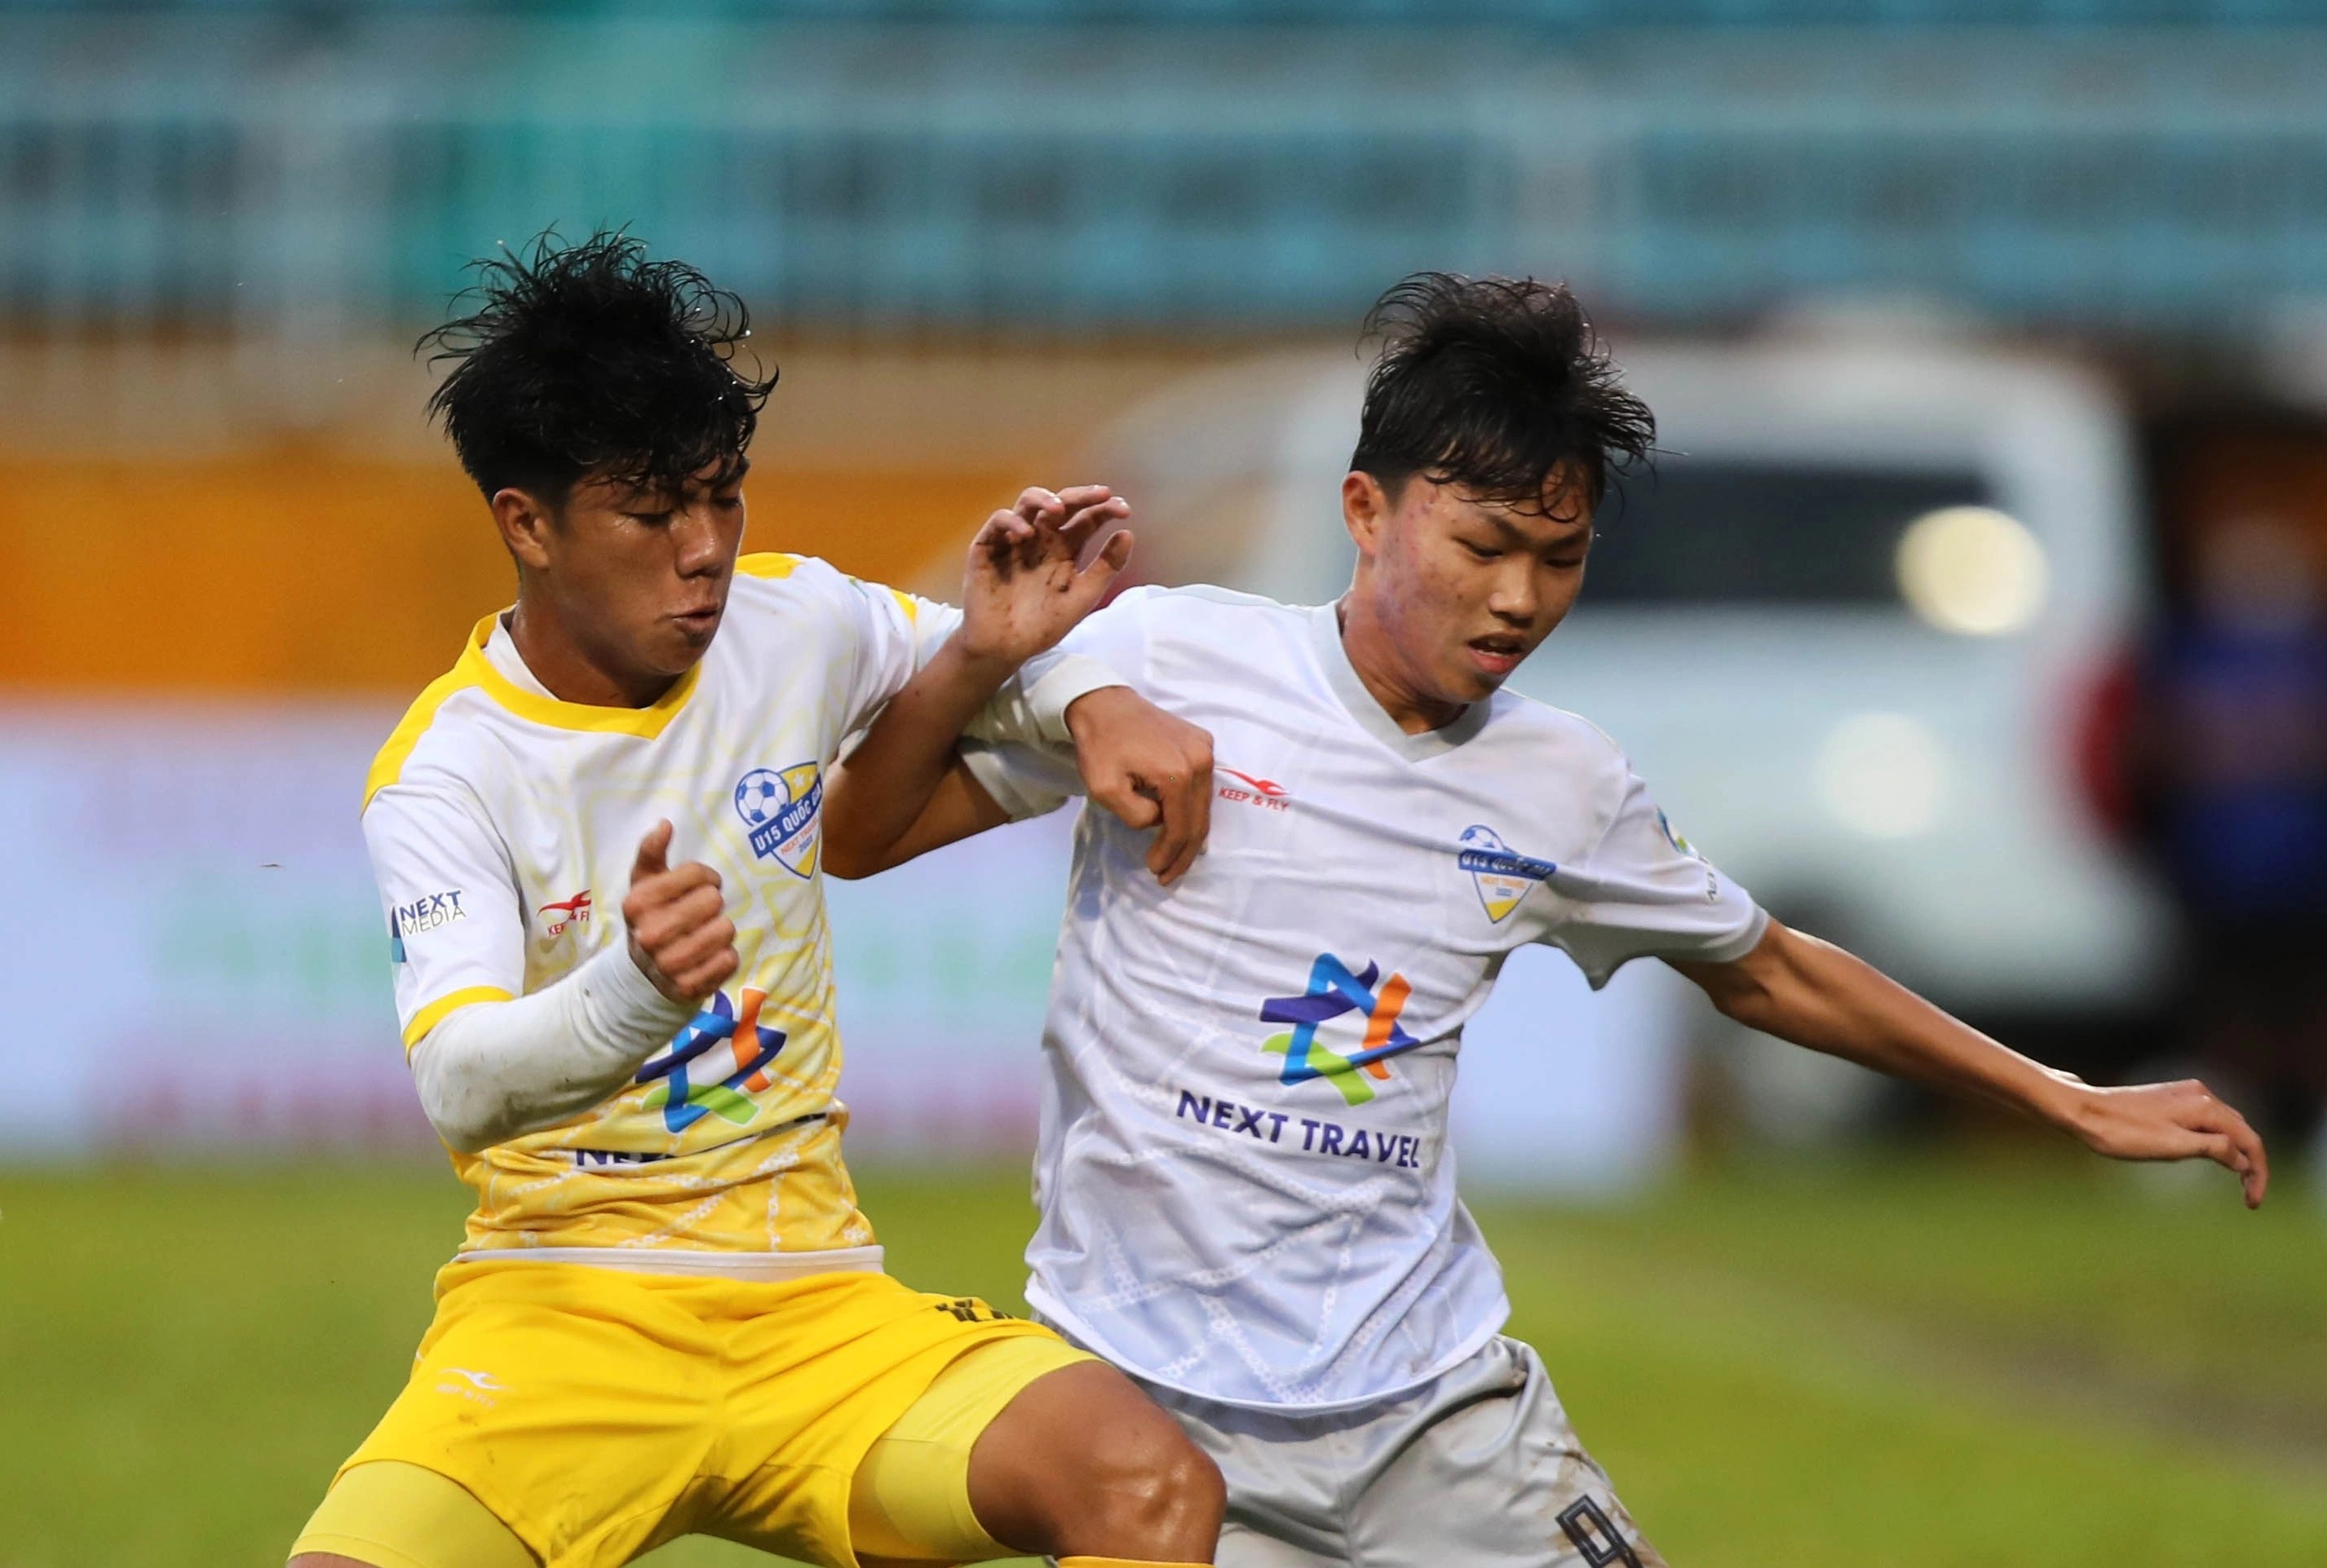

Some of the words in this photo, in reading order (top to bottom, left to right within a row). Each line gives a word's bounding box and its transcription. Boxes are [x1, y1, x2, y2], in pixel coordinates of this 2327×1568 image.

[1219, 788, 1250, 801] KEEP
[1253, 796, 1263, 806] &
[1266, 798, 1290, 811] FLY
[754, 825, 781, 851] U15
[400, 890, 462, 921] NEXT
[401, 906, 467, 937] MEDIA
[1176, 1089, 1289, 1143] NEXT
[1301, 1119, 1420, 1168] TRAVEL
